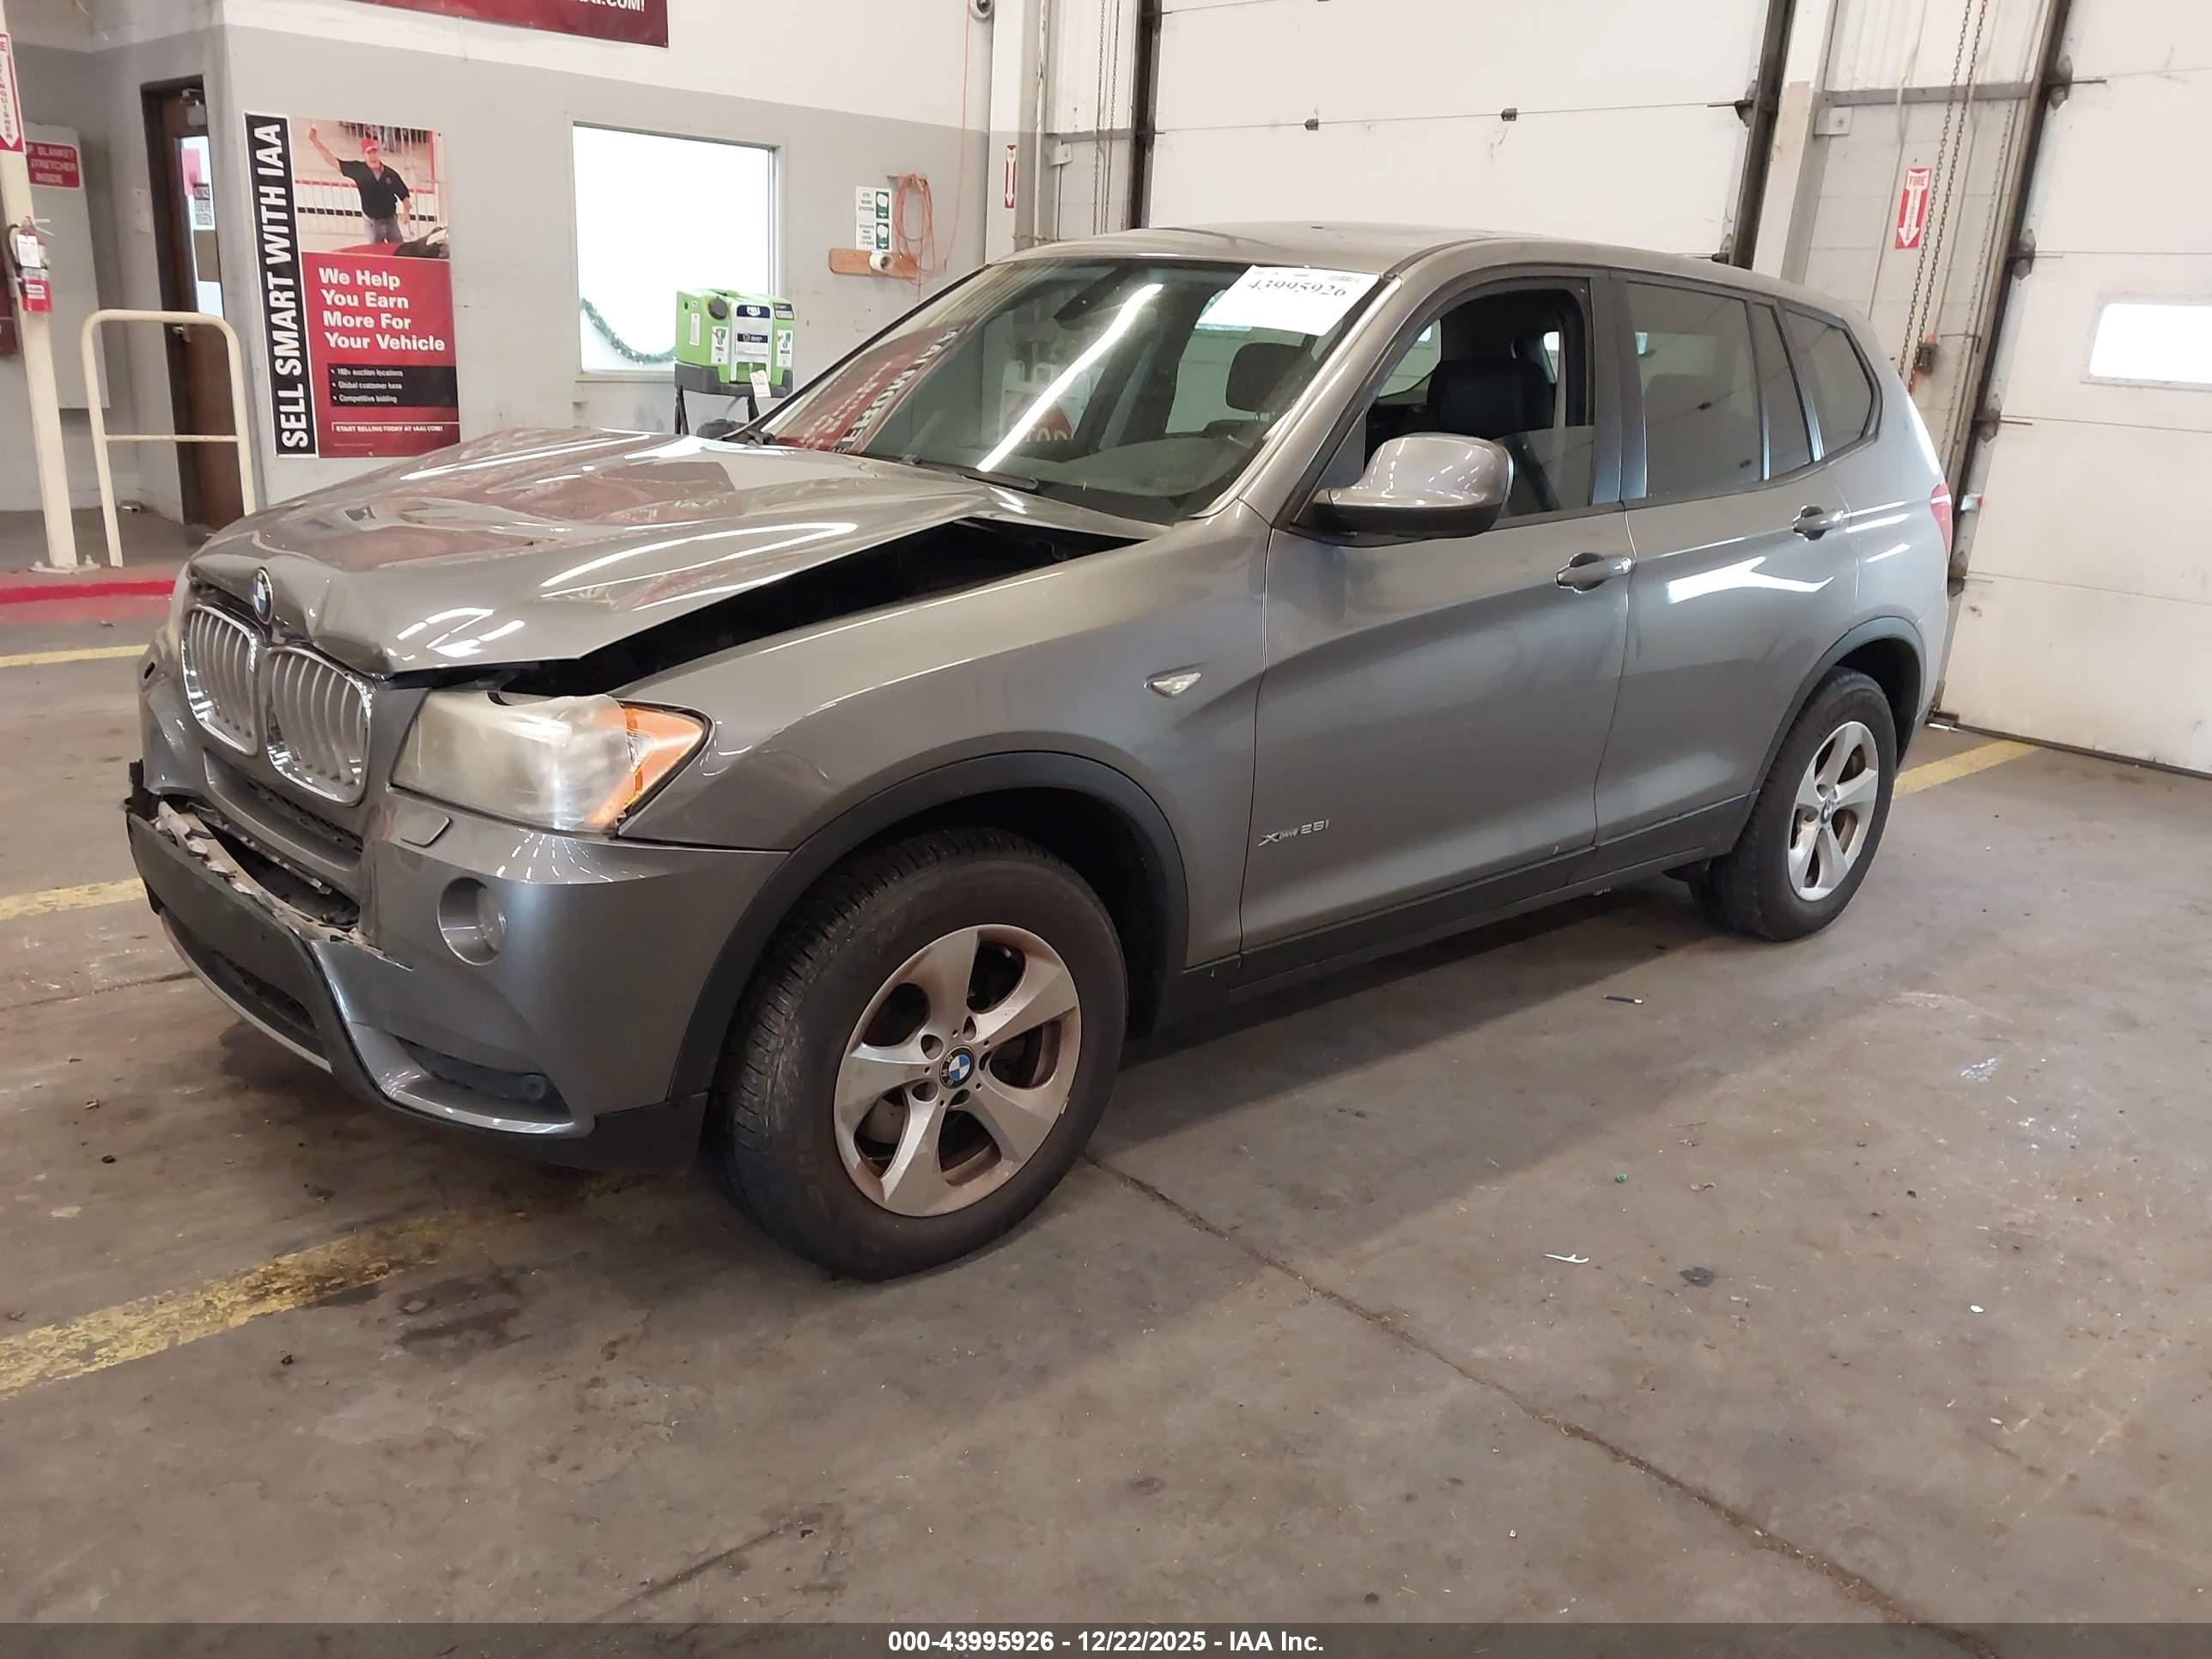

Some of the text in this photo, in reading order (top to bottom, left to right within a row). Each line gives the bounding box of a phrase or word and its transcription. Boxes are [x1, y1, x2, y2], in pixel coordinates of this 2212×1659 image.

[254, 123, 309, 449] SELL SMART WITH IAA
[318, 267, 401, 291] We Help
[320, 289, 410, 309] You Earn
[322, 310, 412, 331] More For
[324, 331, 446, 351] Your Vehicle
[337, 380, 358, 389] Global
[338, 395, 375, 404] Competitive
